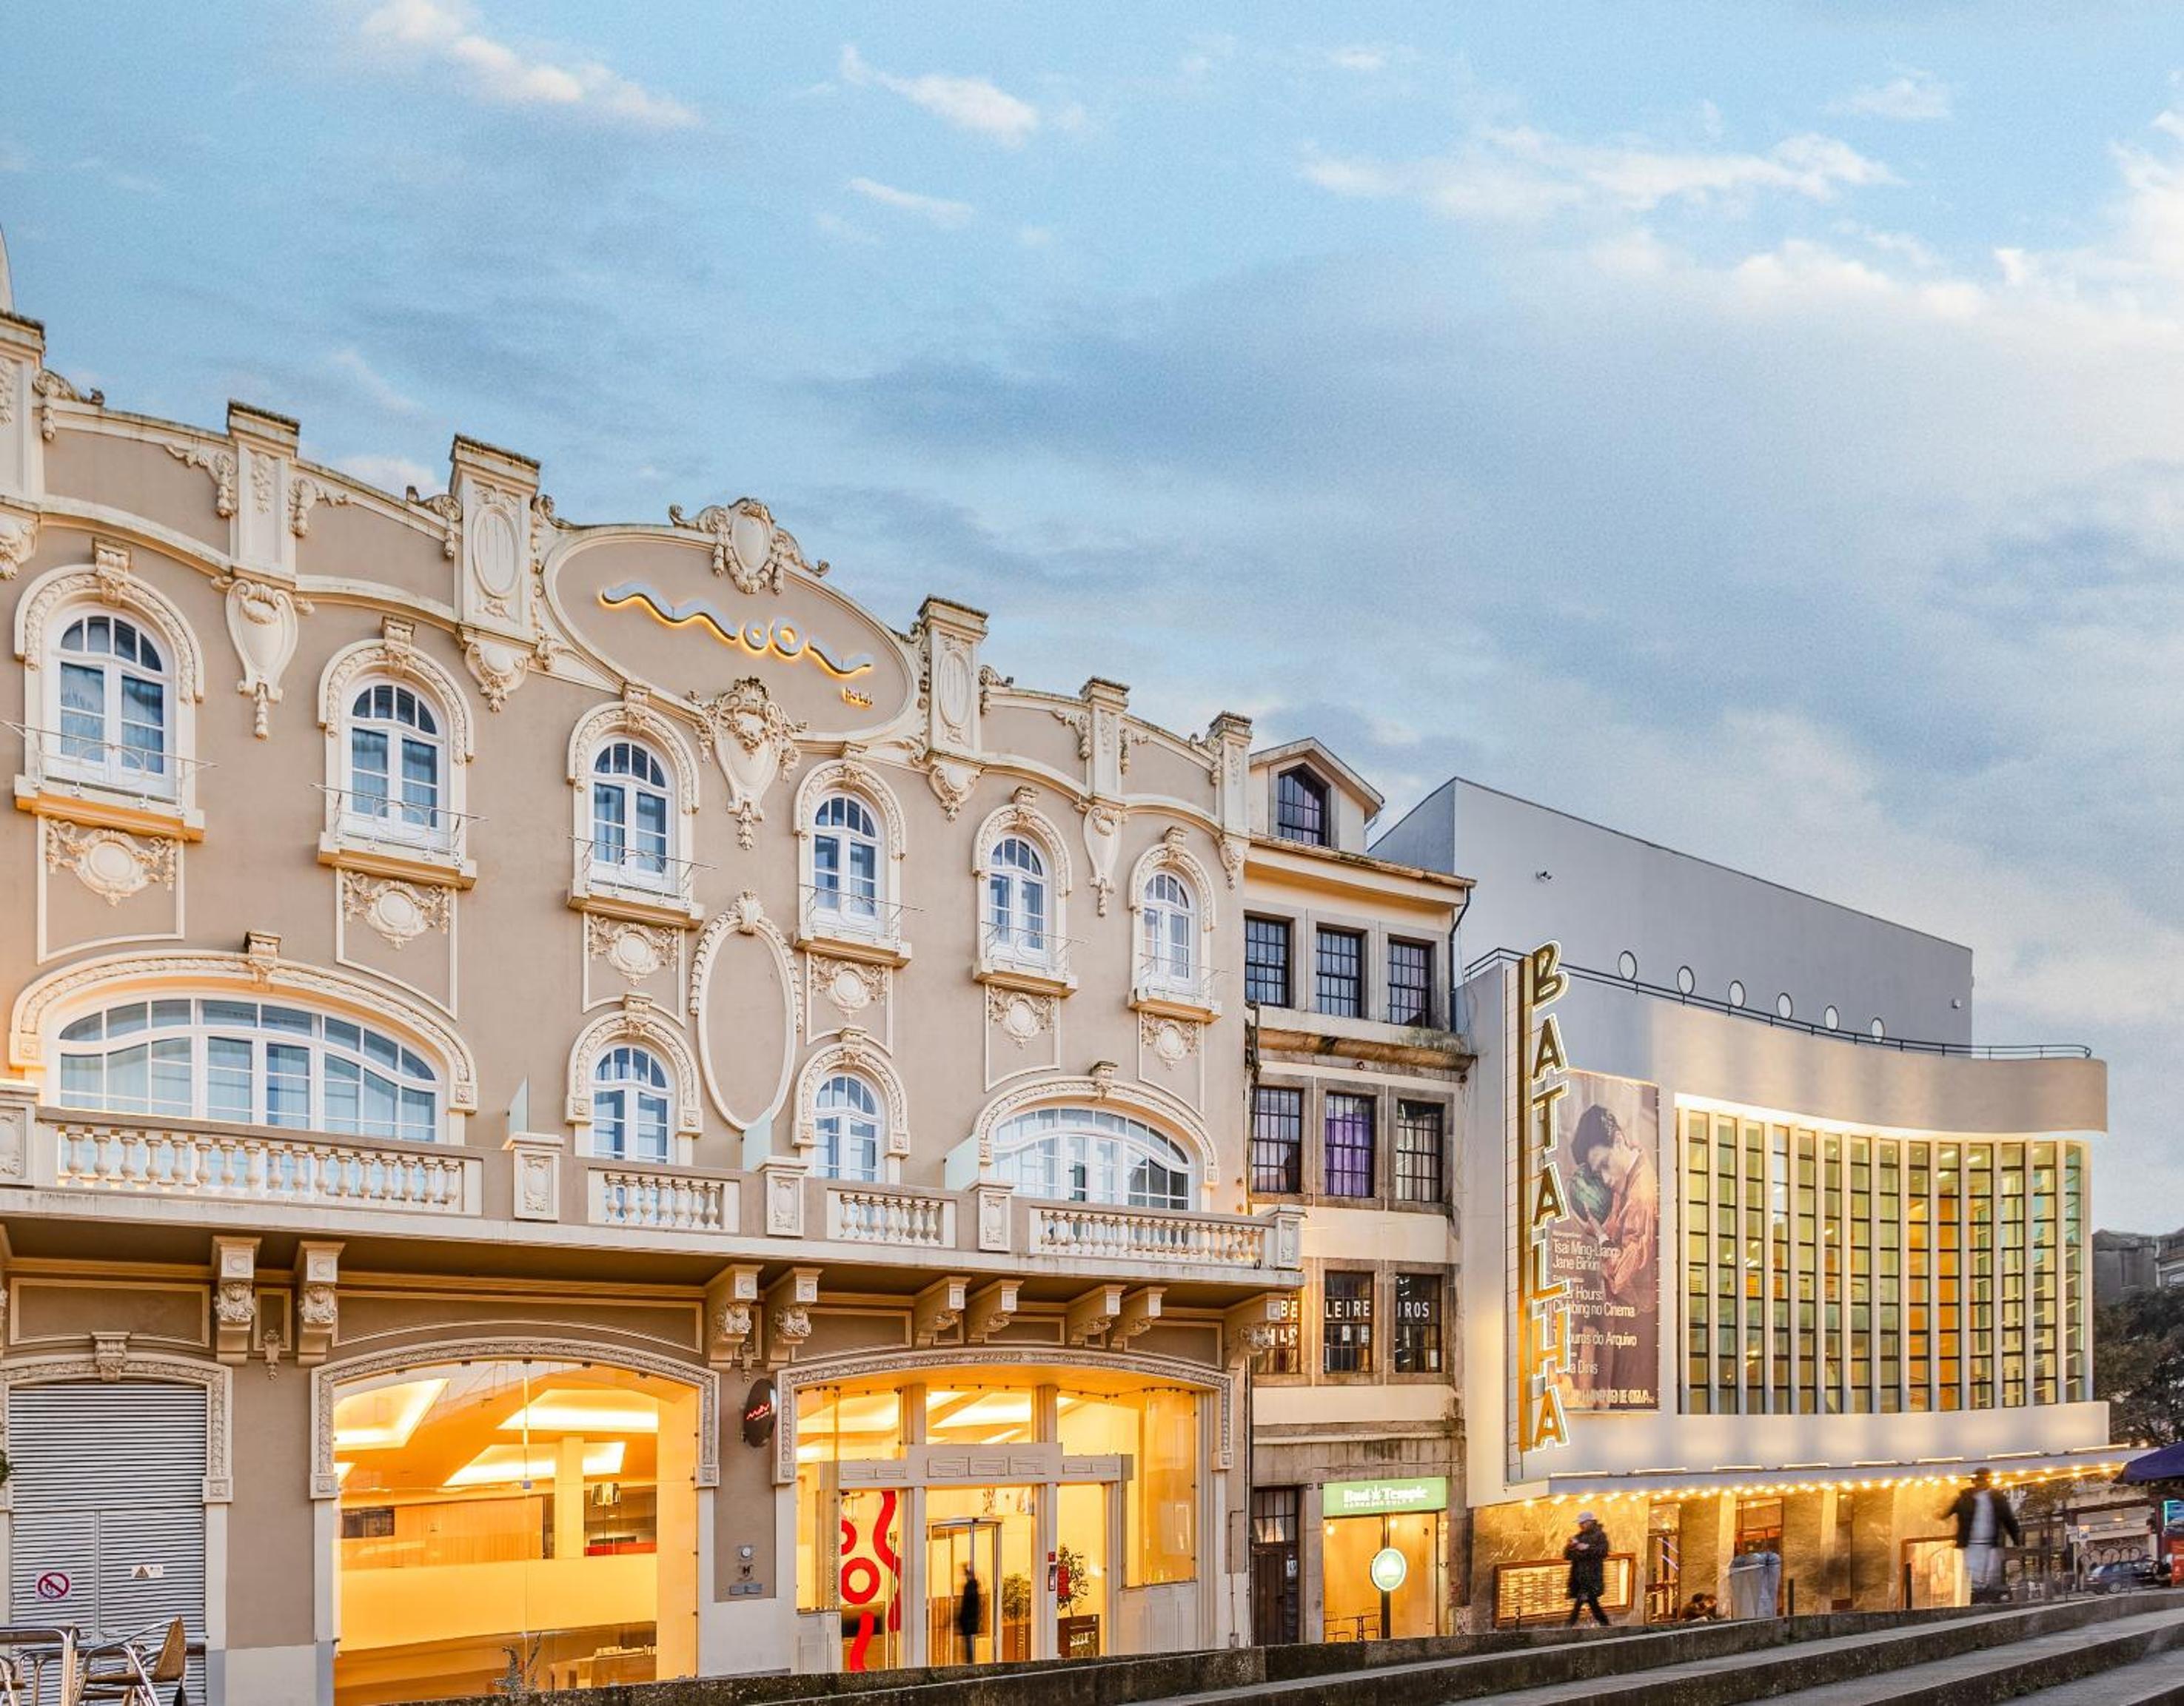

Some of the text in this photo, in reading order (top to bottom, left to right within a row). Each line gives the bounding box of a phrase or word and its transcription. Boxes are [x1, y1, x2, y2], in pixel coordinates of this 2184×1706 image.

[1532, 939, 1571, 1452] BATALHA
[1552, 1255, 1575, 1269] Jane
[1591, 1304, 1602, 1314] no
[1604, 1303, 1635, 1317] Cinema
[1592, 1331, 1604, 1345] do
[1606, 1331, 1638, 1349] Arquivo
